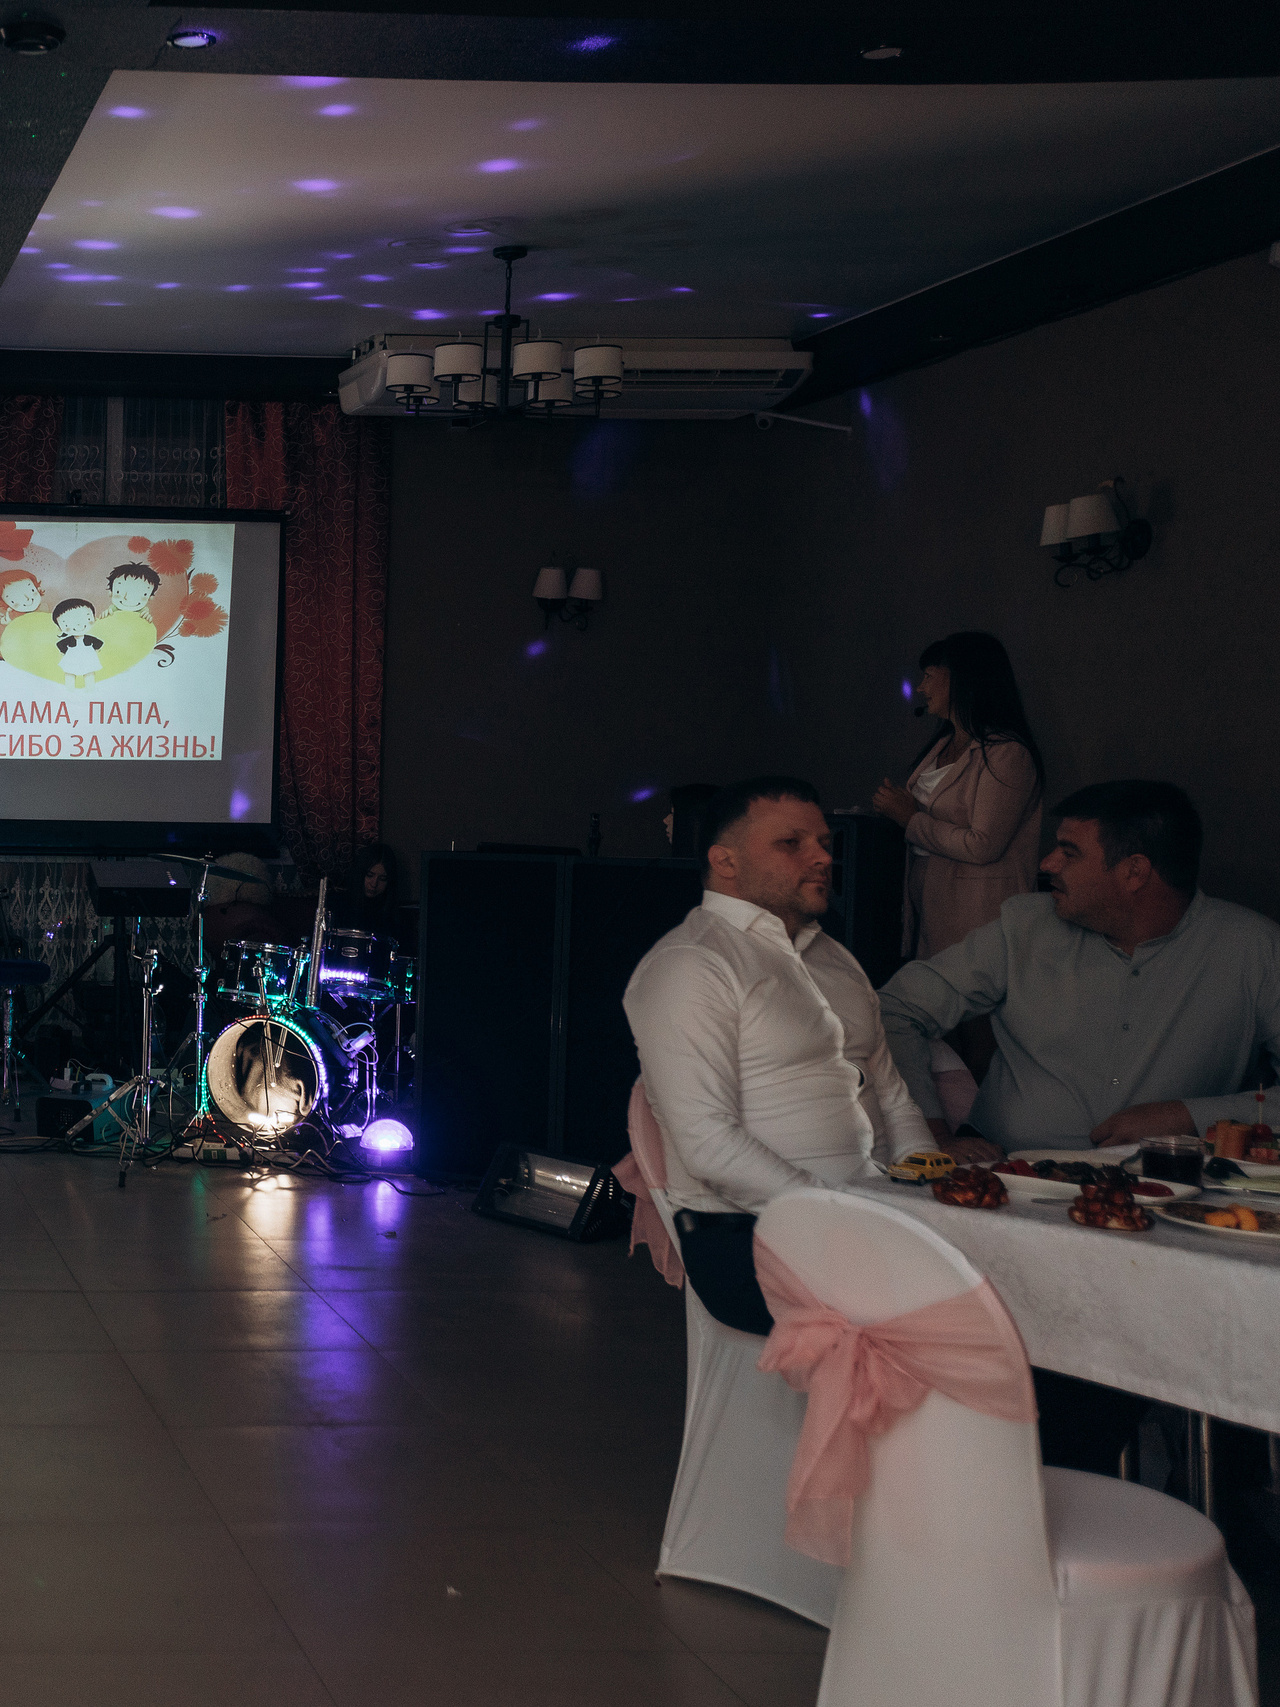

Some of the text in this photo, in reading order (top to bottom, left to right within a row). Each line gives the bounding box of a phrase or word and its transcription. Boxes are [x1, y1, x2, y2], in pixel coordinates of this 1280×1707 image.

[88, 702, 170, 728] ПАПА,
[70, 735, 102, 757] ЗА
[110, 736, 216, 758] ЖИЗНЬ!
